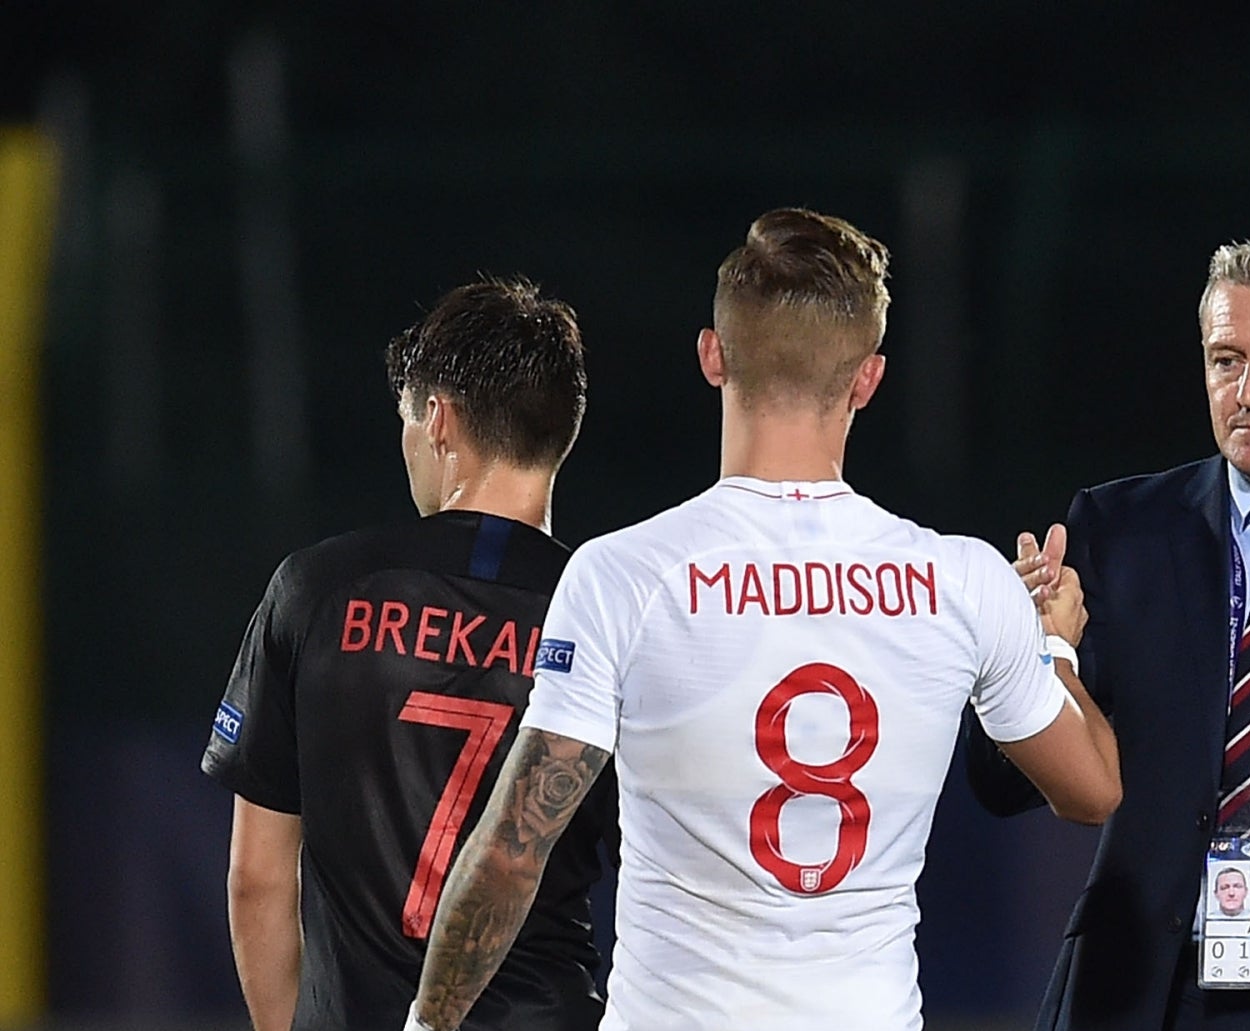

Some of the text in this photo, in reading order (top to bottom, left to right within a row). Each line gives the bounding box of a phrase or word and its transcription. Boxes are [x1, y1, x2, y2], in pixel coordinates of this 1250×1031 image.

[689, 562, 937, 616] MADDISON
[398, 690, 515, 938] 7
[750, 663, 879, 896] 8
[1212, 941, 1224, 959] 0
[1239, 941, 1249, 959] 1
